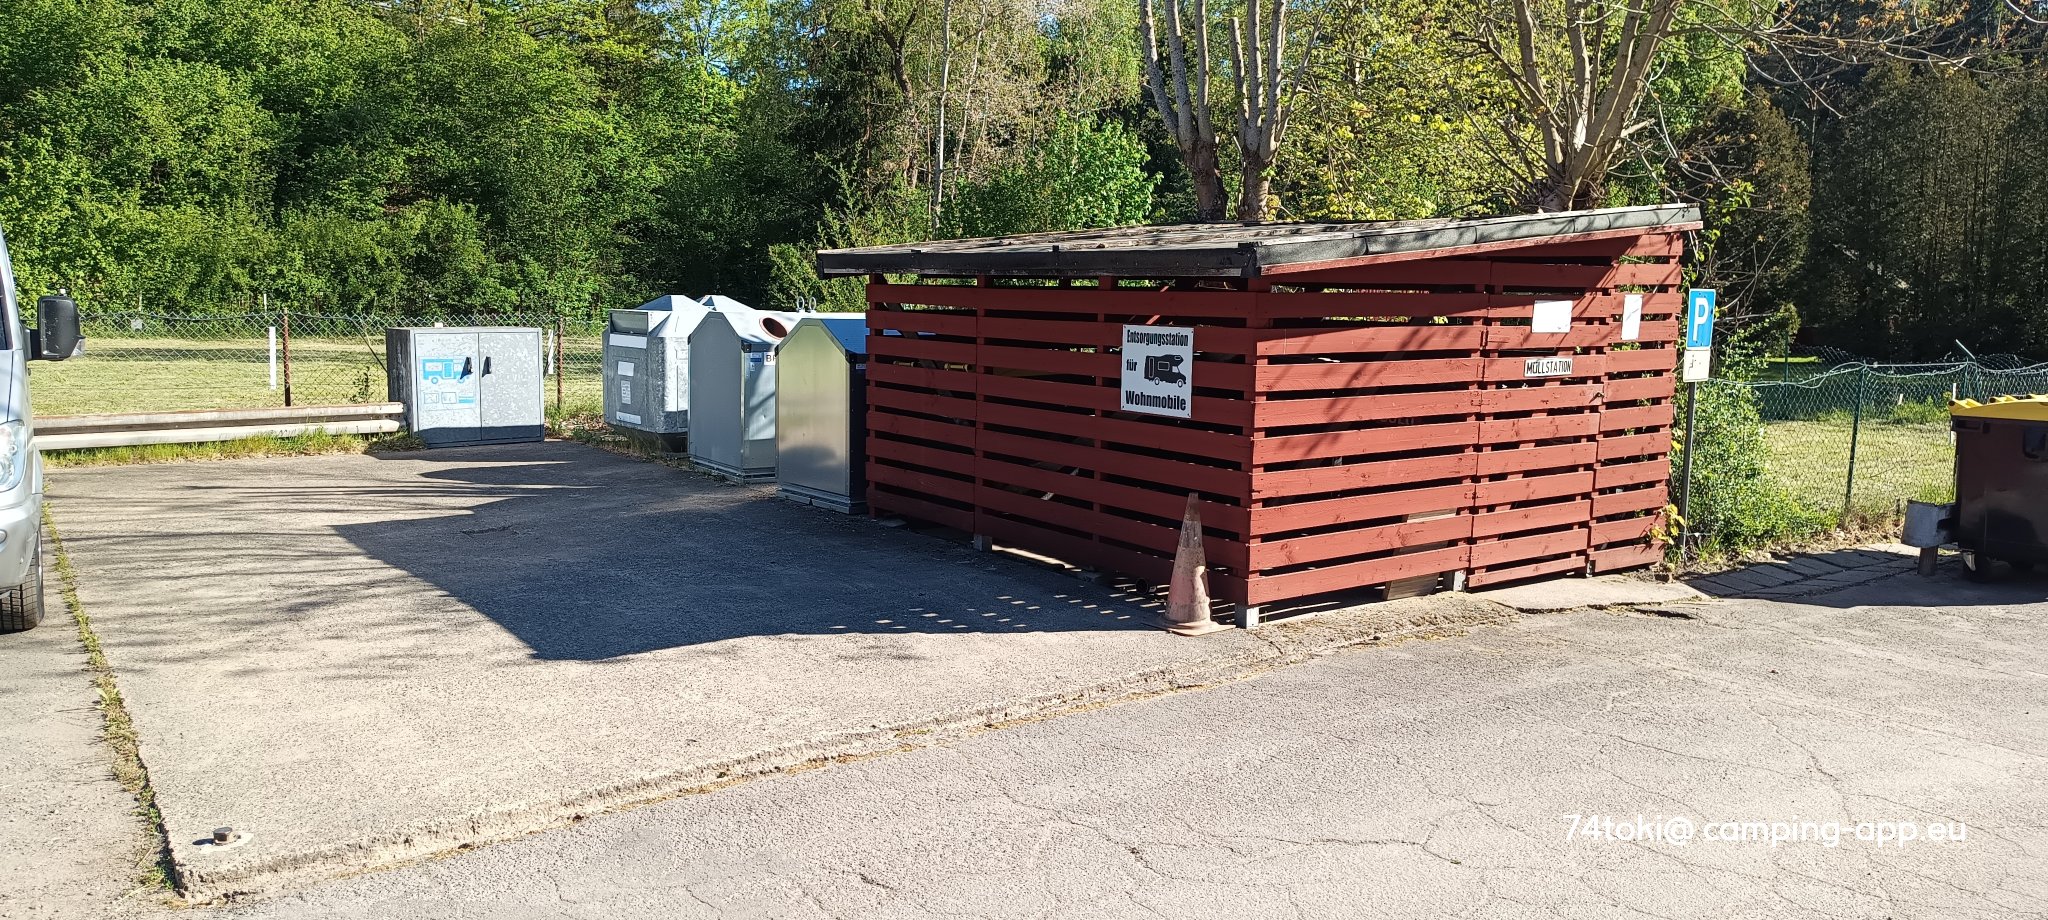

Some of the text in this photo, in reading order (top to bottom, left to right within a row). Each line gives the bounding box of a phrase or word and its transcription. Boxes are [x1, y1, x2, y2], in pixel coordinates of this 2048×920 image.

[1692, 297, 1709, 342] P
[1126, 329, 1189, 346] Entsorgungsstation
[1126, 359, 1138, 371] für
[1526, 360, 1572, 374] MÜLLSTATION
[1125, 390, 1187, 411] Wohnmobile
